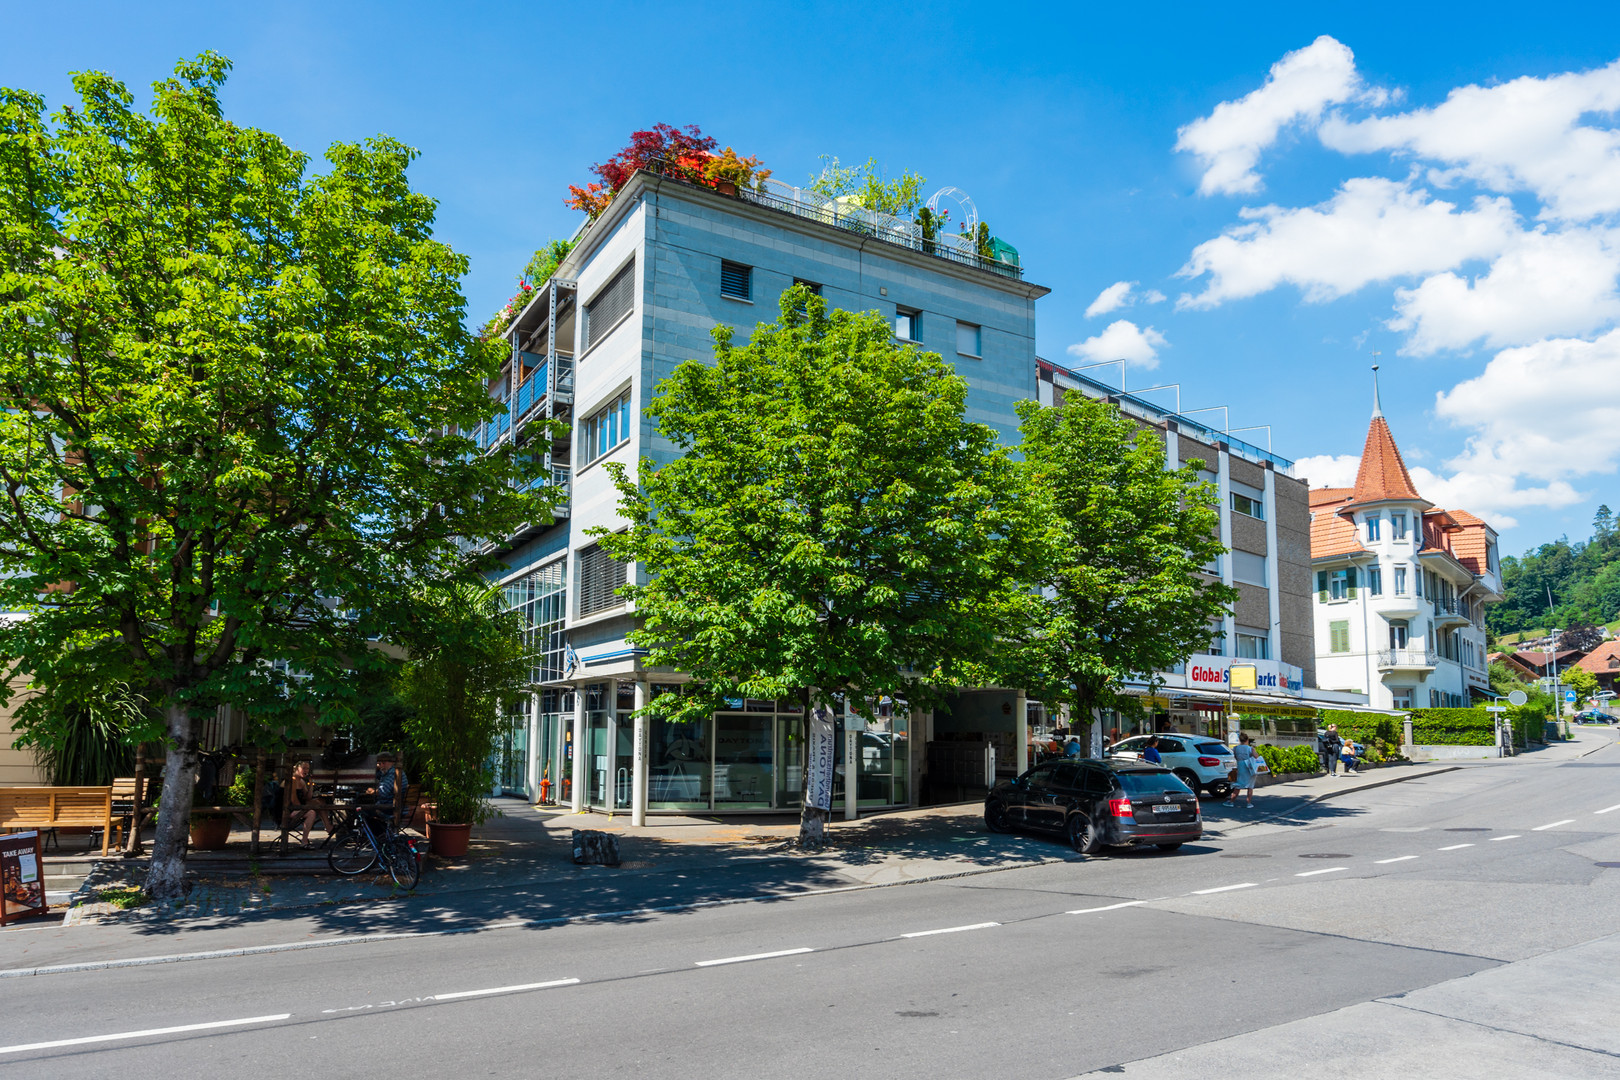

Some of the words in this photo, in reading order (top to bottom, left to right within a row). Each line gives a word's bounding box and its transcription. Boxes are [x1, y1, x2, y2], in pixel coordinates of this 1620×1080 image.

[1247, 706, 1280, 714] SUPERMARKT
[2, 849, 17, 858] TAKE
[17, 847, 34, 855] AWAY
